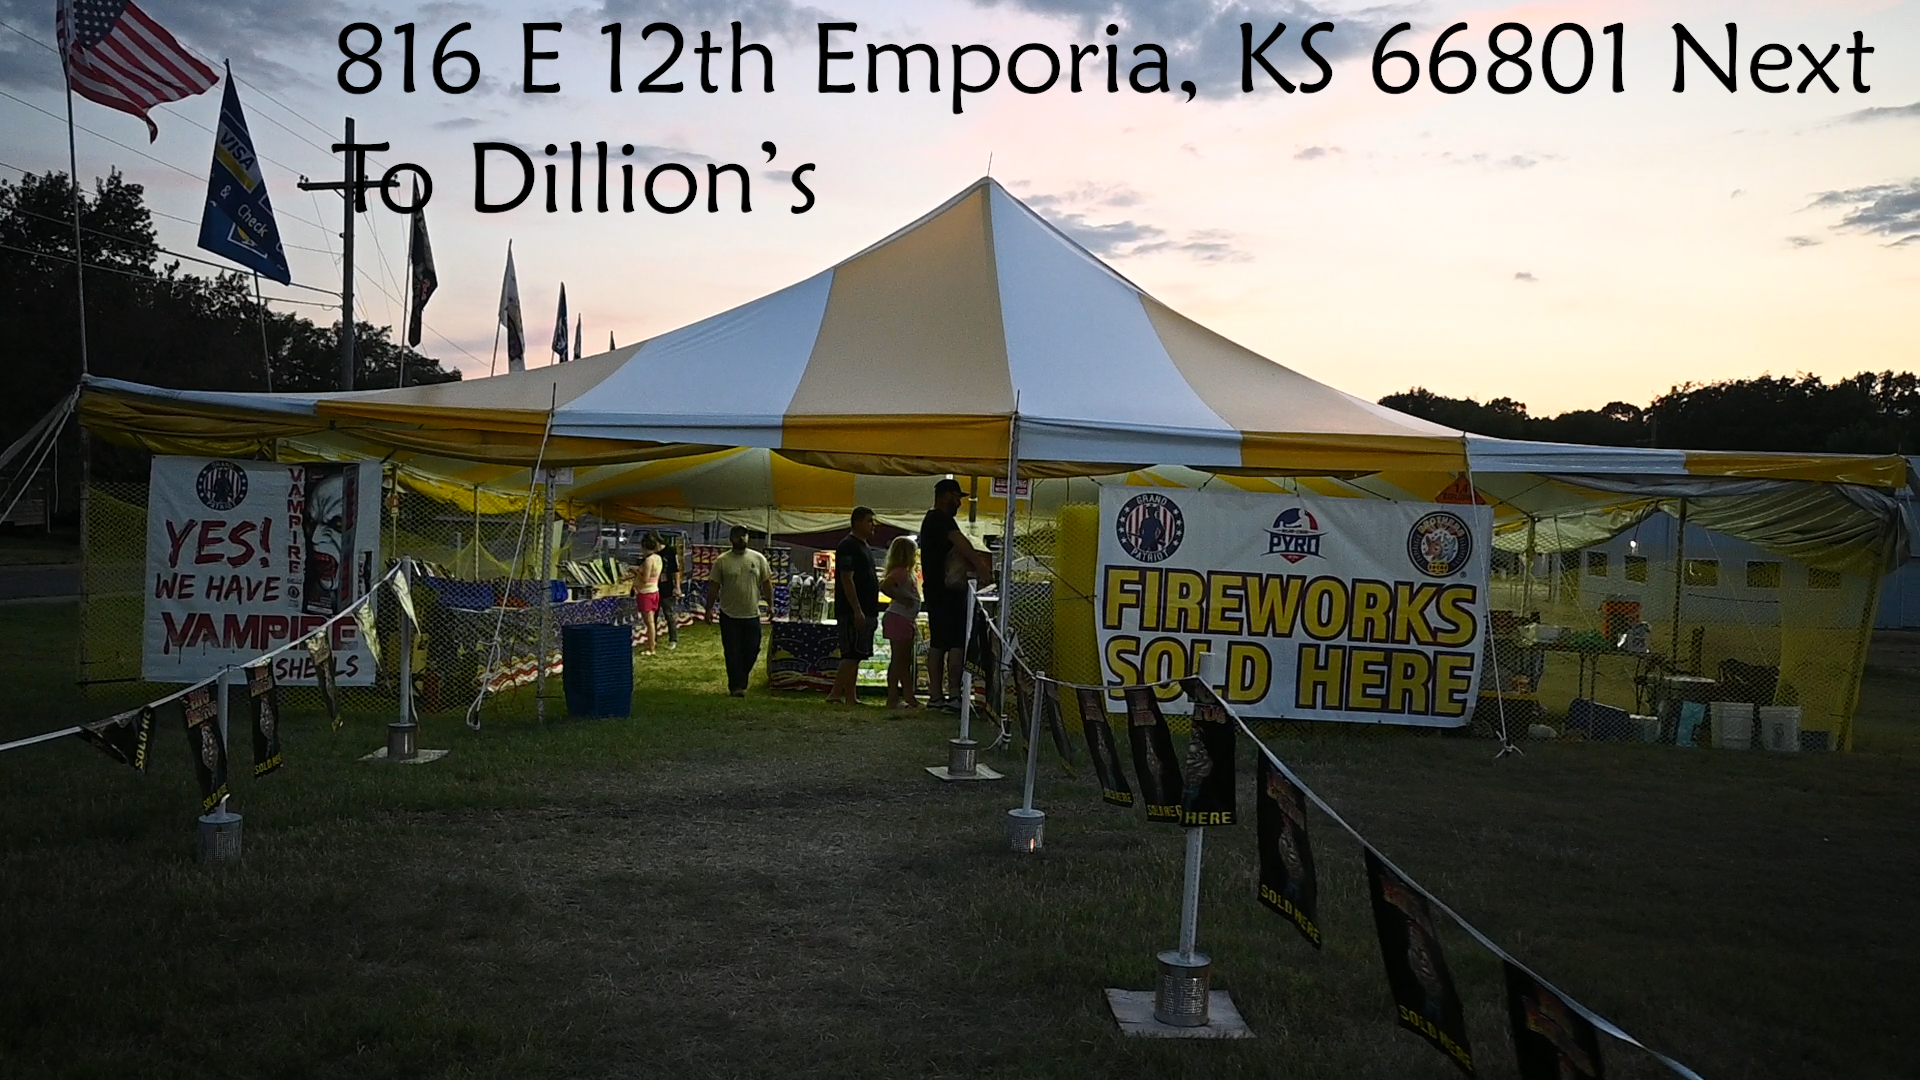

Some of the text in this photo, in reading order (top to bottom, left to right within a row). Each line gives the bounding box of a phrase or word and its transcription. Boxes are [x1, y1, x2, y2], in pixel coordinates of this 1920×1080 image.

[220, 131, 255, 171] VISA
[237, 203, 268, 238] Check
[1135, 494, 1168, 506] GRAND
[287, 467, 306, 574] VAMPIRE
[165, 517, 272, 569] YES!
[1130, 547, 1169, 562] PATRIOT
[1269, 532, 1320, 556] PYRO
[155, 572, 281, 603] WE HAVE
[1102, 564, 1478, 649] FIREWORKS
[275, 654, 359, 681] SHELS
[1294, 643, 1476, 717] HERE
[1185, 811, 1233, 825] HERE
[1260, 883, 1321, 945] SOLD HERE
[1399, 1003, 1438, 1039] SOLD
